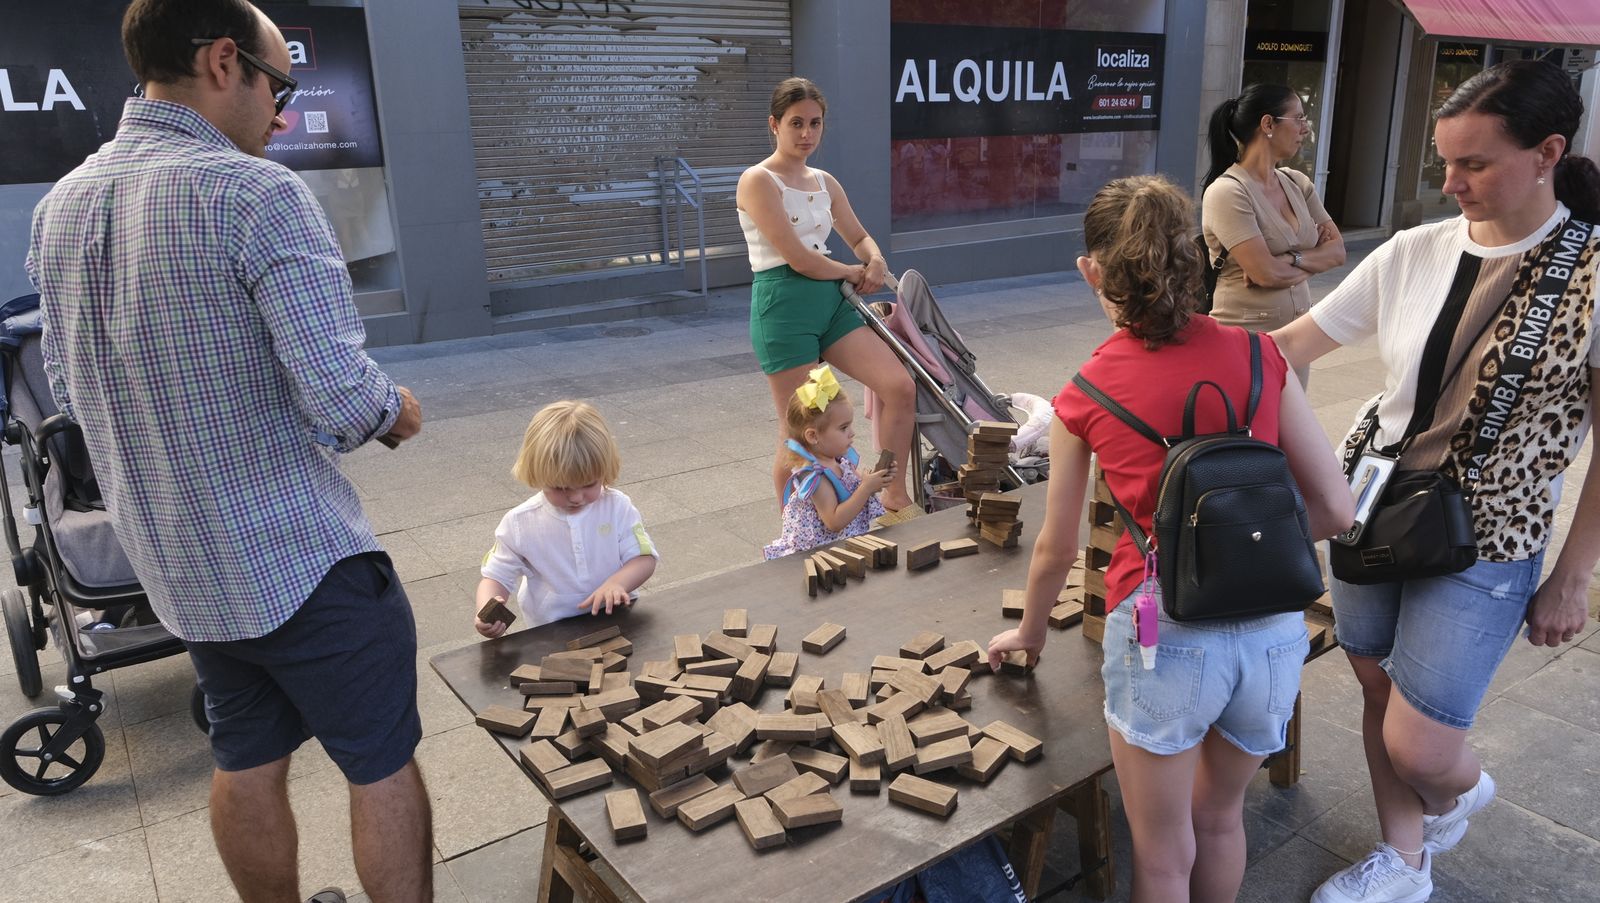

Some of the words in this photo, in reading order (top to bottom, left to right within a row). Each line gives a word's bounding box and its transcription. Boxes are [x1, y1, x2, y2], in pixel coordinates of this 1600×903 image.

[1097, 48, 1150, 68] localiza
[0, 68, 87, 112] LA
[895, 59, 1072, 105] ALQUILA
[1099, 98, 1110, 106] 601
[1111, 98, 1119, 106] 24
[1545, 219, 1592, 281] BIMBA
[1510, 293, 1561, 361] BIMBA
[1480, 372, 1526, 441] BIMBA
